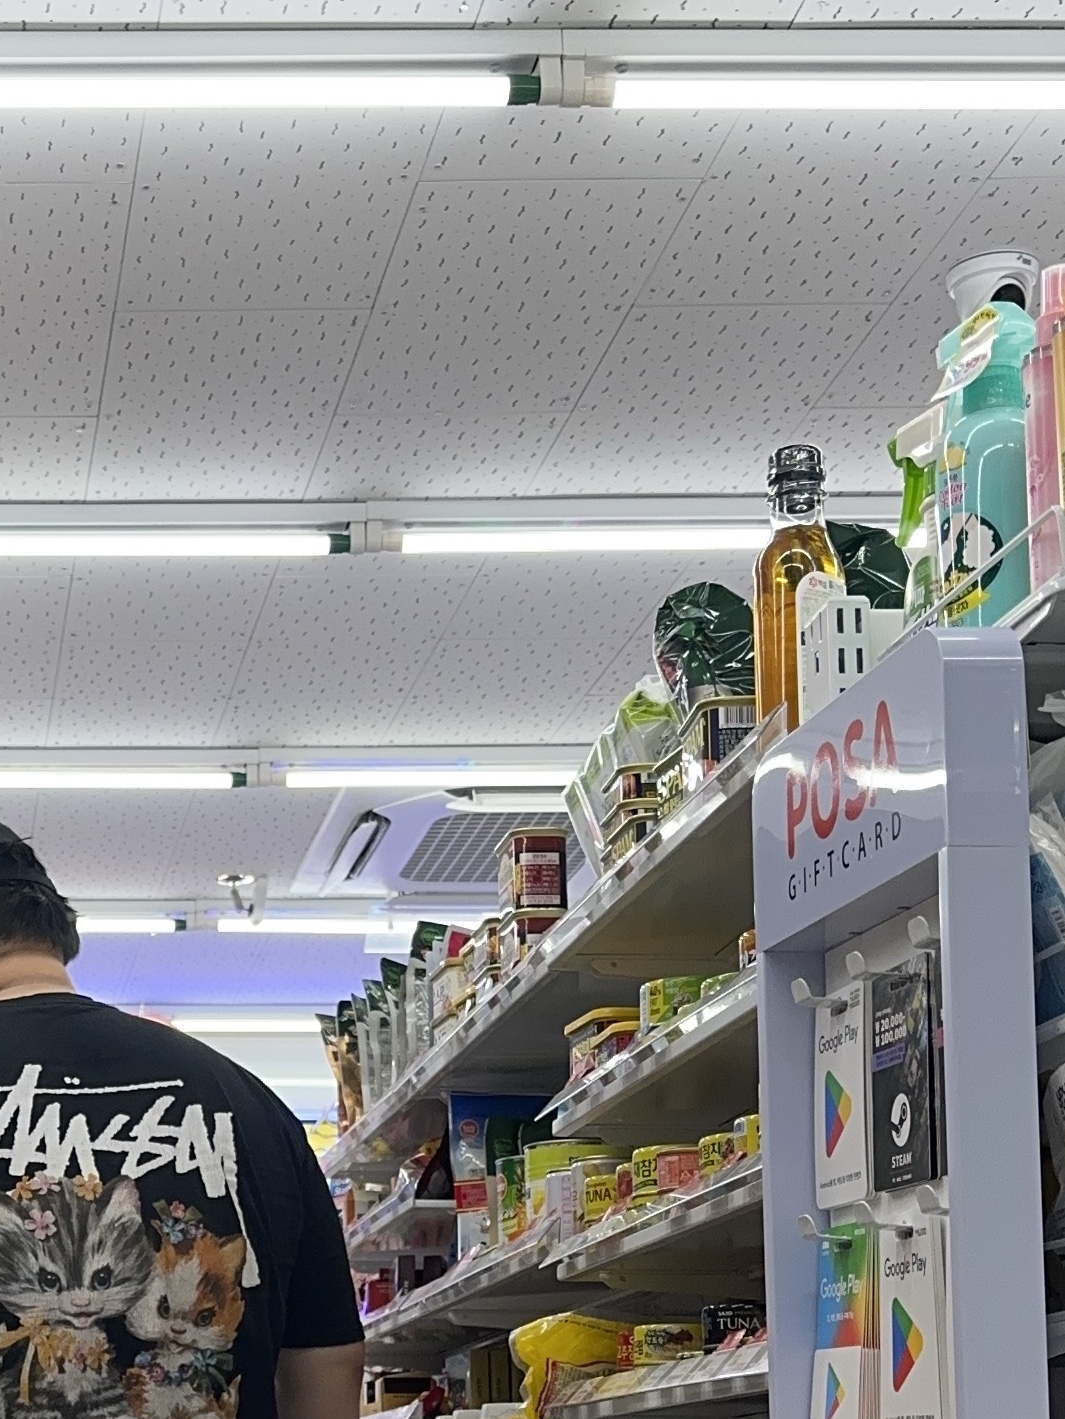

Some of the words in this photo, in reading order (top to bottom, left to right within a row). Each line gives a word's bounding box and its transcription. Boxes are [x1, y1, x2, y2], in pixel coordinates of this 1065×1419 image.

[787, 700, 899, 861] POSA
[818, 1032, 843, 1055] Google
[844, 1023, 860, 1048] Play
[891, 1151, 912, 1169] STEAM
[884, 1257, 911, 1281] Google
[911, 1252, 927, 1277] Play
[819, 1277, 847, 1302] Google
[847, 1273, 863, 1296] Play
[716, 1317, 761, 1331] TUNA
